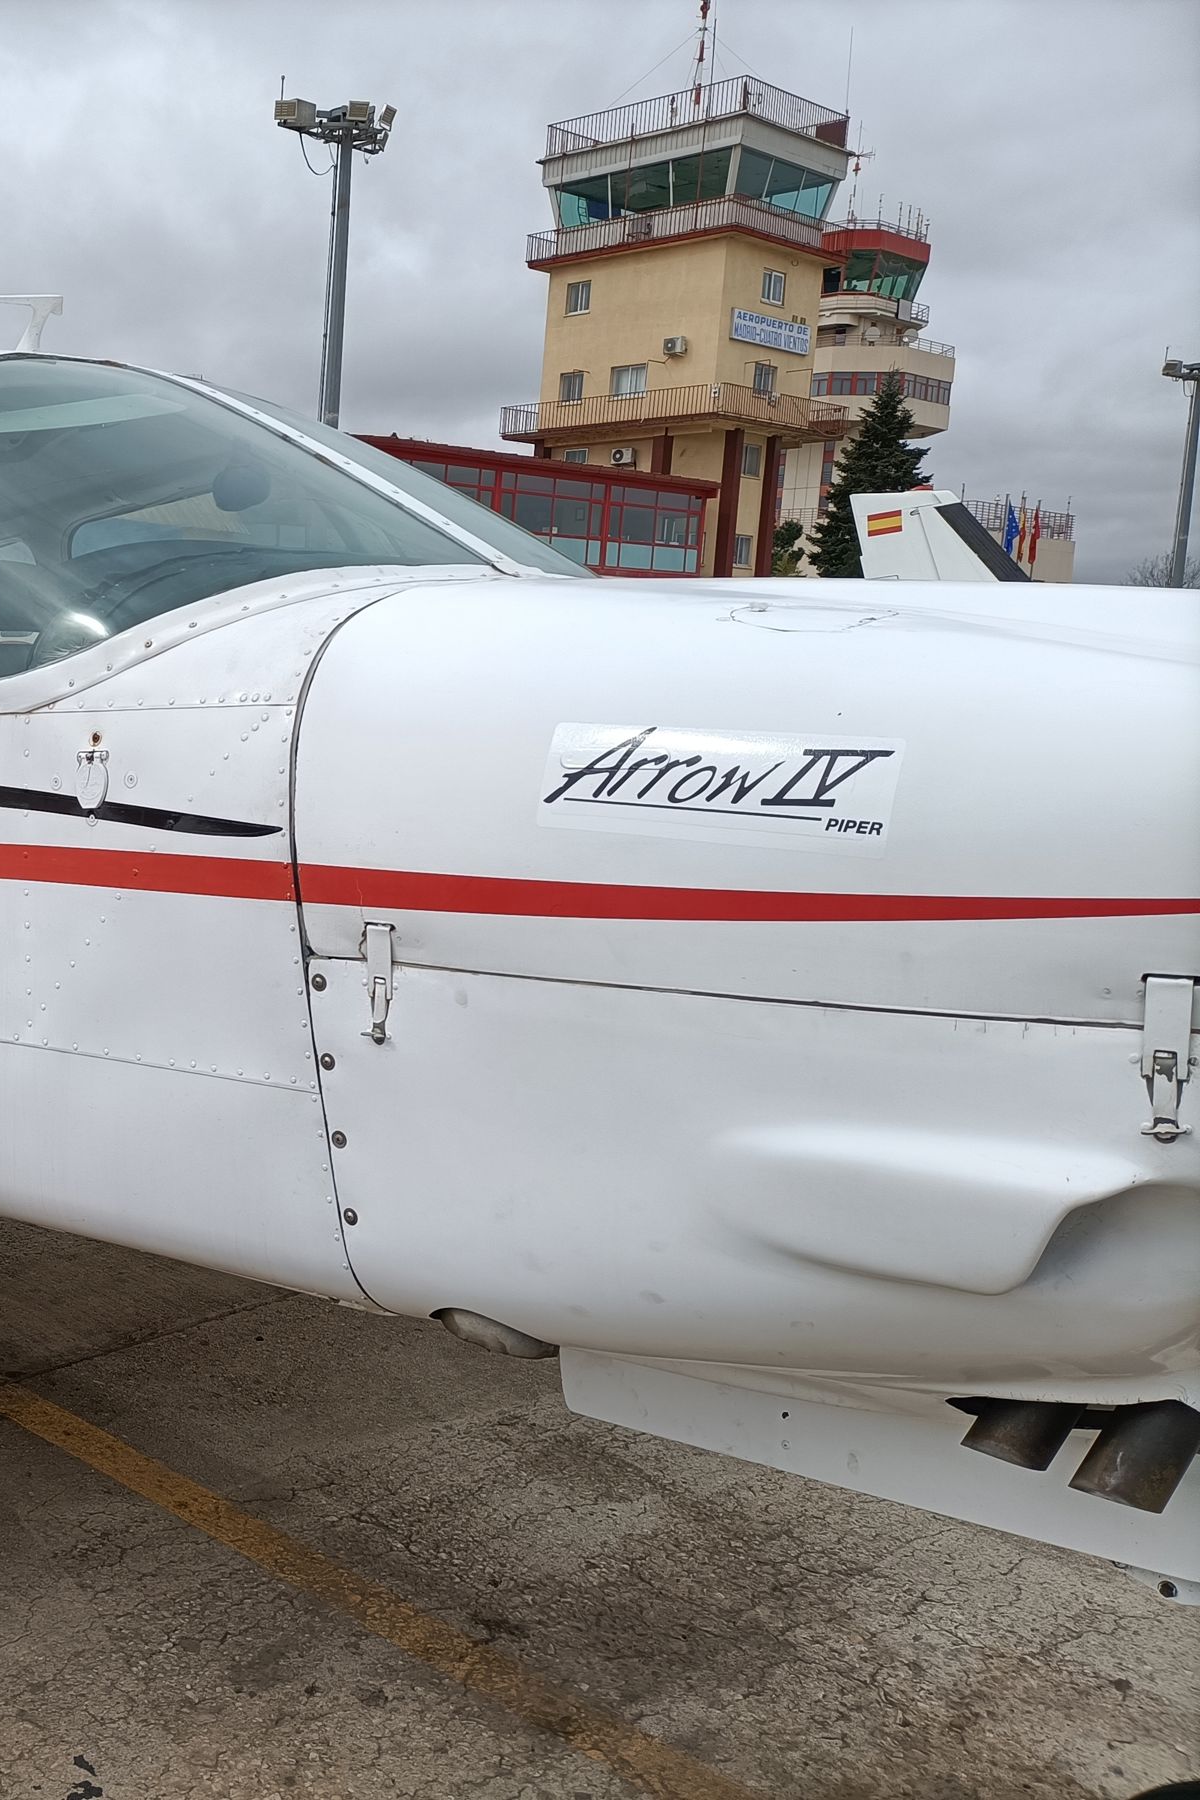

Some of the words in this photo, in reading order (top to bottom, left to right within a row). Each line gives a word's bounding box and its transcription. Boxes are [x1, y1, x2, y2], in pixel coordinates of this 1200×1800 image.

[734, 322, 782, 347] MADRID-CUATRO
[783, 335, 809, 353] VIENTOS
[736, 311, 794, 333] AEROPUERTO
[797, 326, 809, 336] DE
[543, 726, 785, 804] Arrow
[760, 748, 895, 807] IV
[824, 818, 884, 836] PIPER
